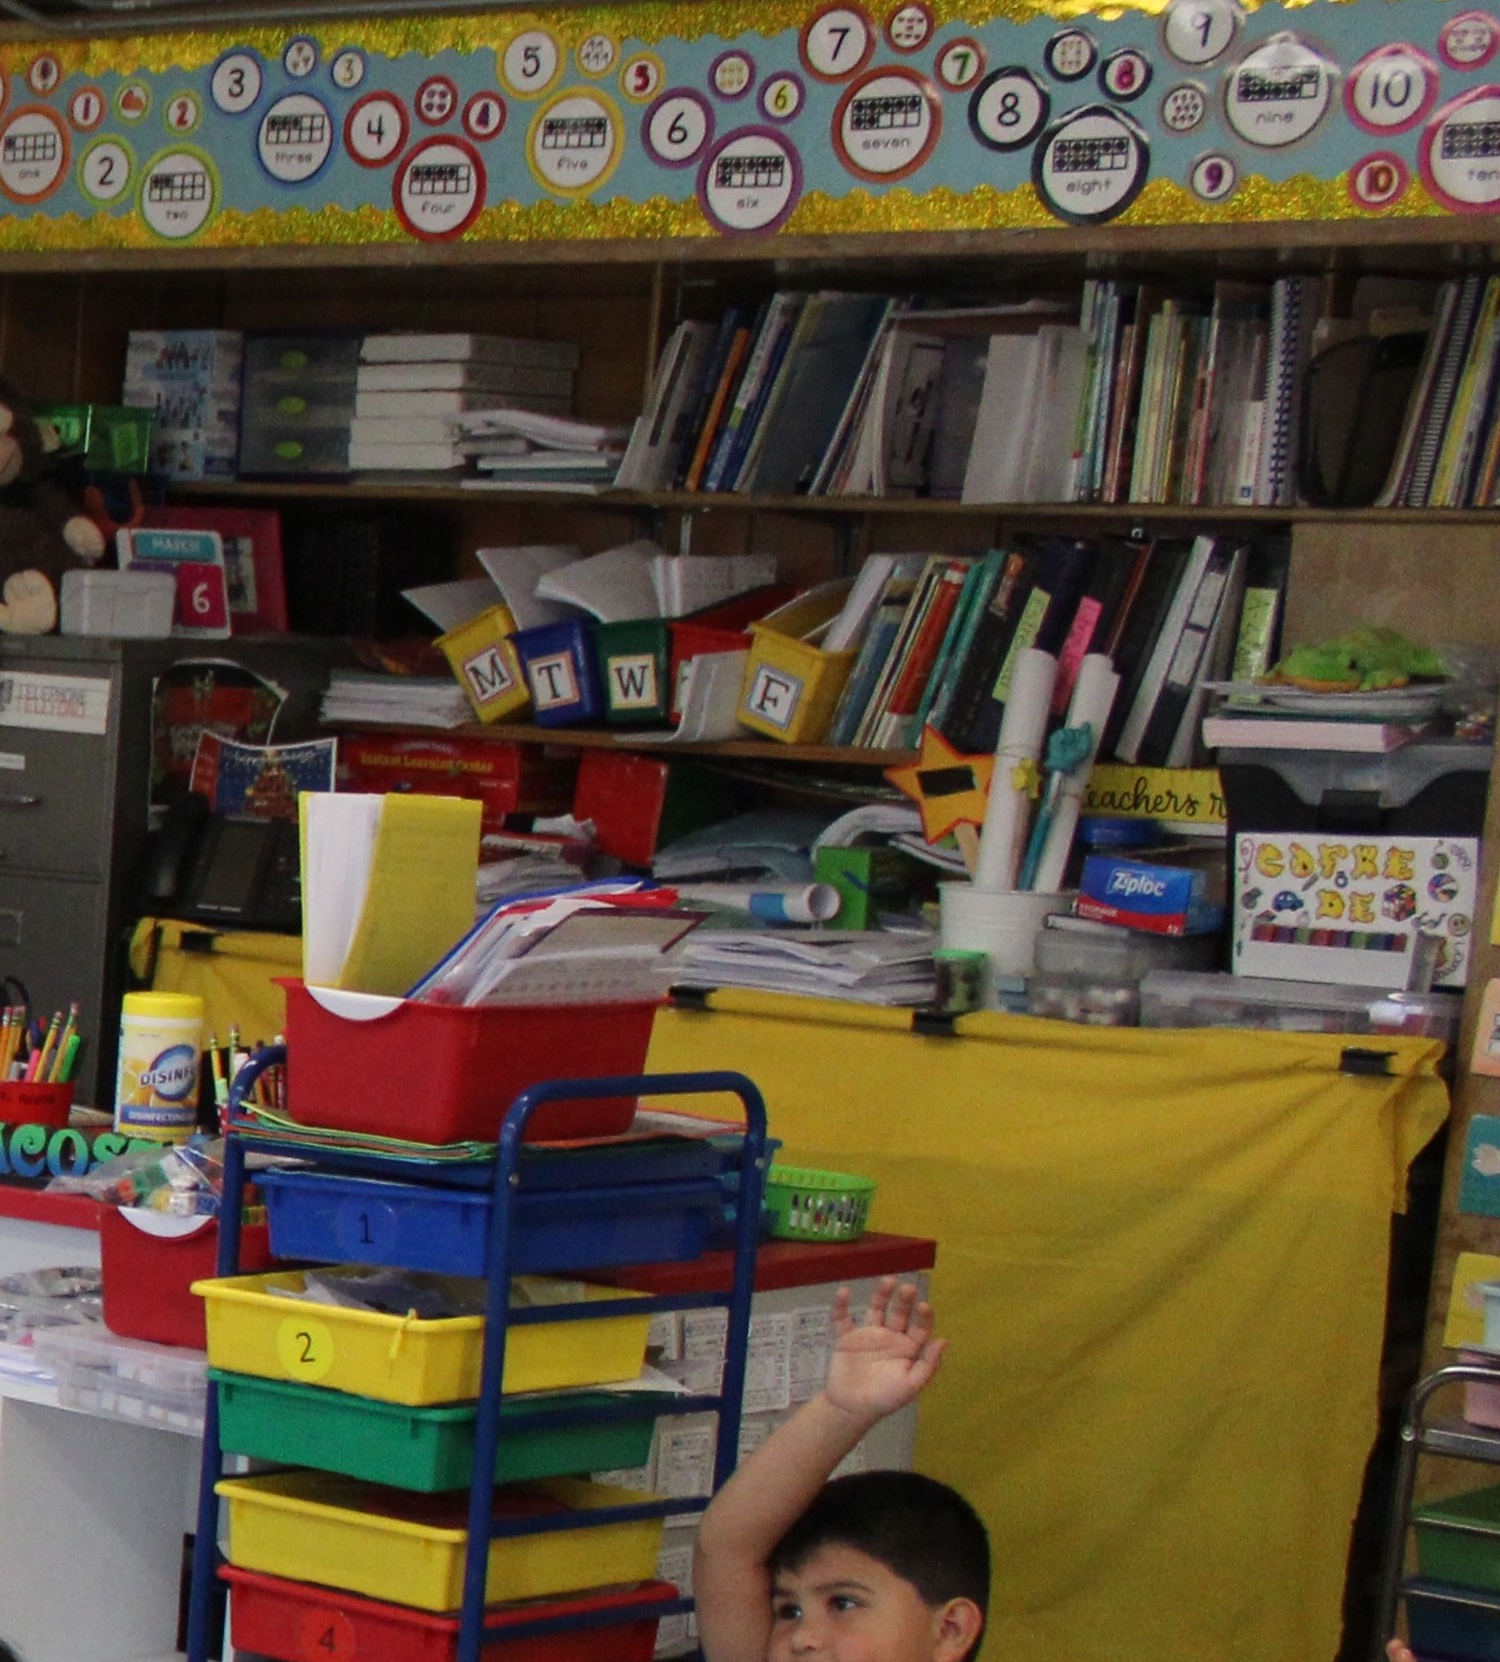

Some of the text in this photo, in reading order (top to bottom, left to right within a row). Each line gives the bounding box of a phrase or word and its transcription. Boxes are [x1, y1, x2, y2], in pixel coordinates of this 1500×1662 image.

[828, 26, 850, 62] 7
[522, 46, 540, 77] 5
[952, 52, 971, 80] 7
[228, 67, 245, 98] 3
[774, 83, 790, 110] 6
[1370, 71, 1411, 109] 10
[996, 92, 1022, 127] 8
[1255, 110, 1294, 126] nine
[365, 114, 385, 144] 4
[668, 111, 689, 144] 6
[861, 136, 911, 150] seven
[98, 157, 115, 187] 2
[556, 157, 588, 172] five
[1205, 162, 1223, 192] 9
[1364, 163, 1394, 196] 10
[1066, 176, 1112, 196] eight
[191, 586, 211, 616] 6
[471, 651, 508, 696] M
[546, 662, 571, 702] T
[614, 662, 648, 700] W
[755, 671, 791, 716] F
[1255, 841, 1418, 882] COFRE
[1111, 869, 1167, 898] Ziploc
[1315, 888, 1376, 924] DE
[360, 1213, 372, 1246] 1
[297, 1331, 315, 1364] 2
[317, 1624, 337, 1655] 4
